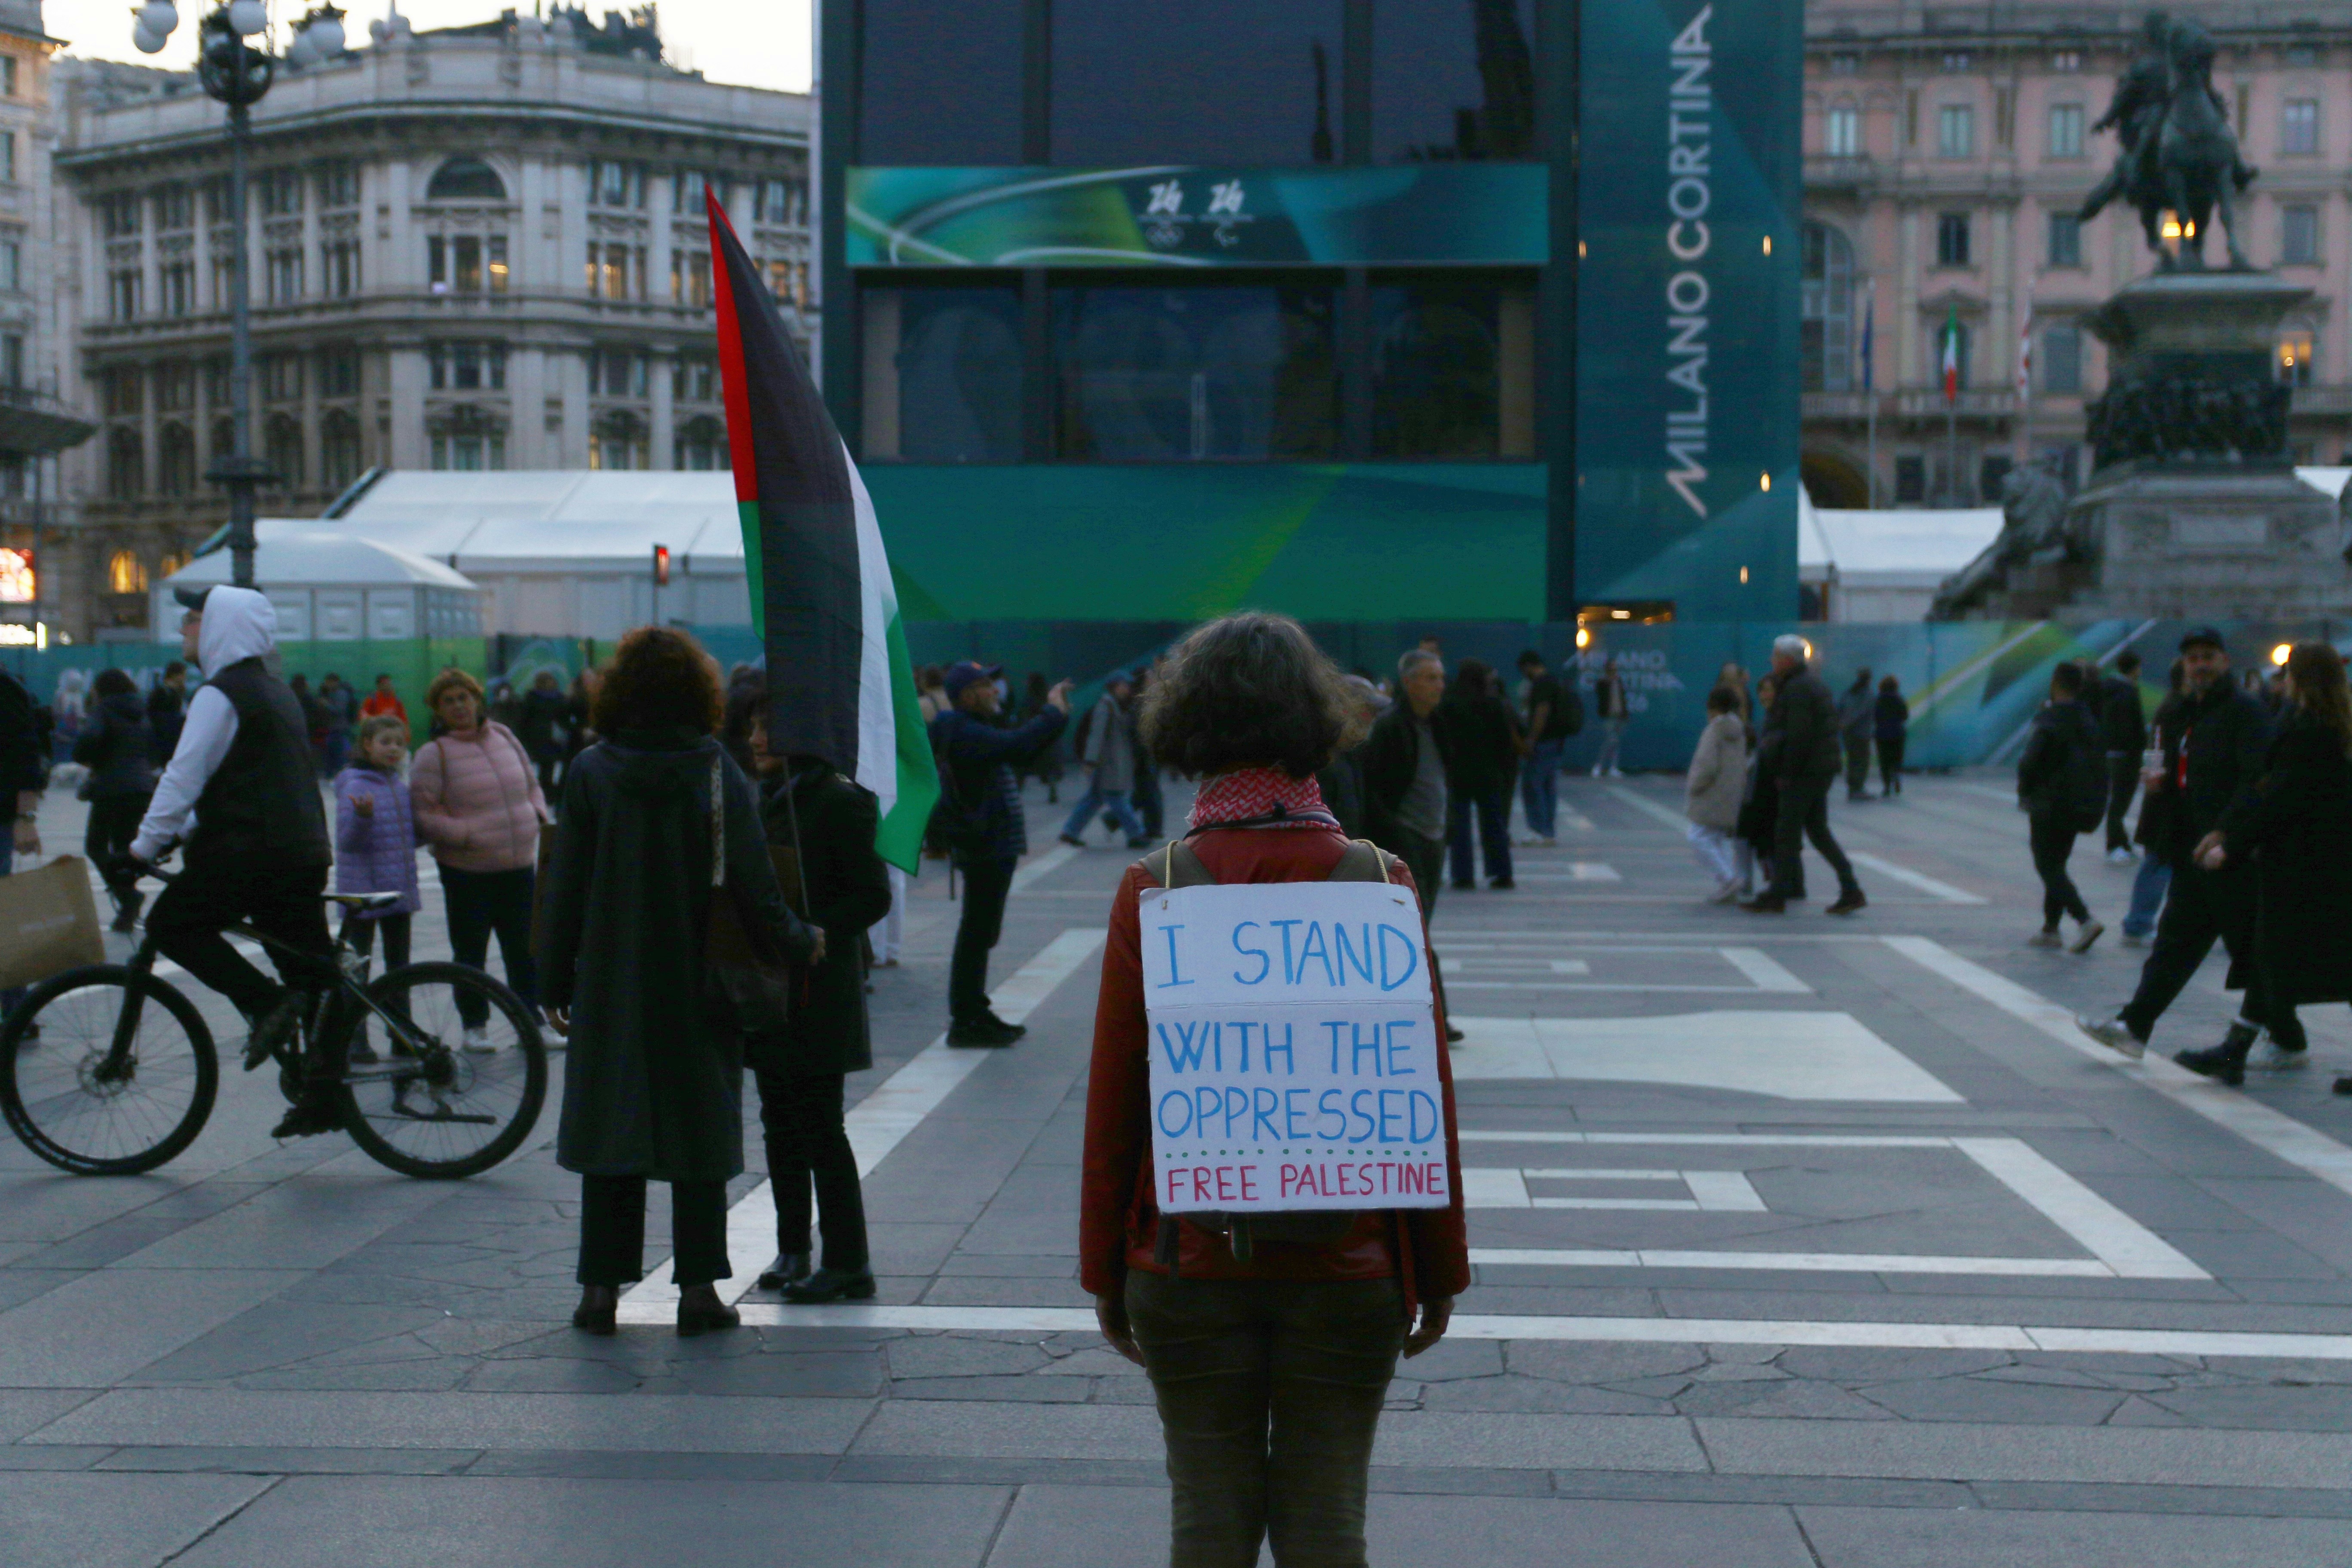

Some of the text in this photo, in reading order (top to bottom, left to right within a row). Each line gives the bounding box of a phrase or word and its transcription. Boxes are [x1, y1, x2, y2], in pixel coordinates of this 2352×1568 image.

[1666, 2, 1713, 519] MILANO CORTINA
[1157, 919, 1418, 992] I STAND
[1155, 1020, 1416, 1078] WITH THE
[1157, 1086, 1438, 1145] OPPRESSED
[1167, 1162, 1445, 1203] FREE PALESTINE
